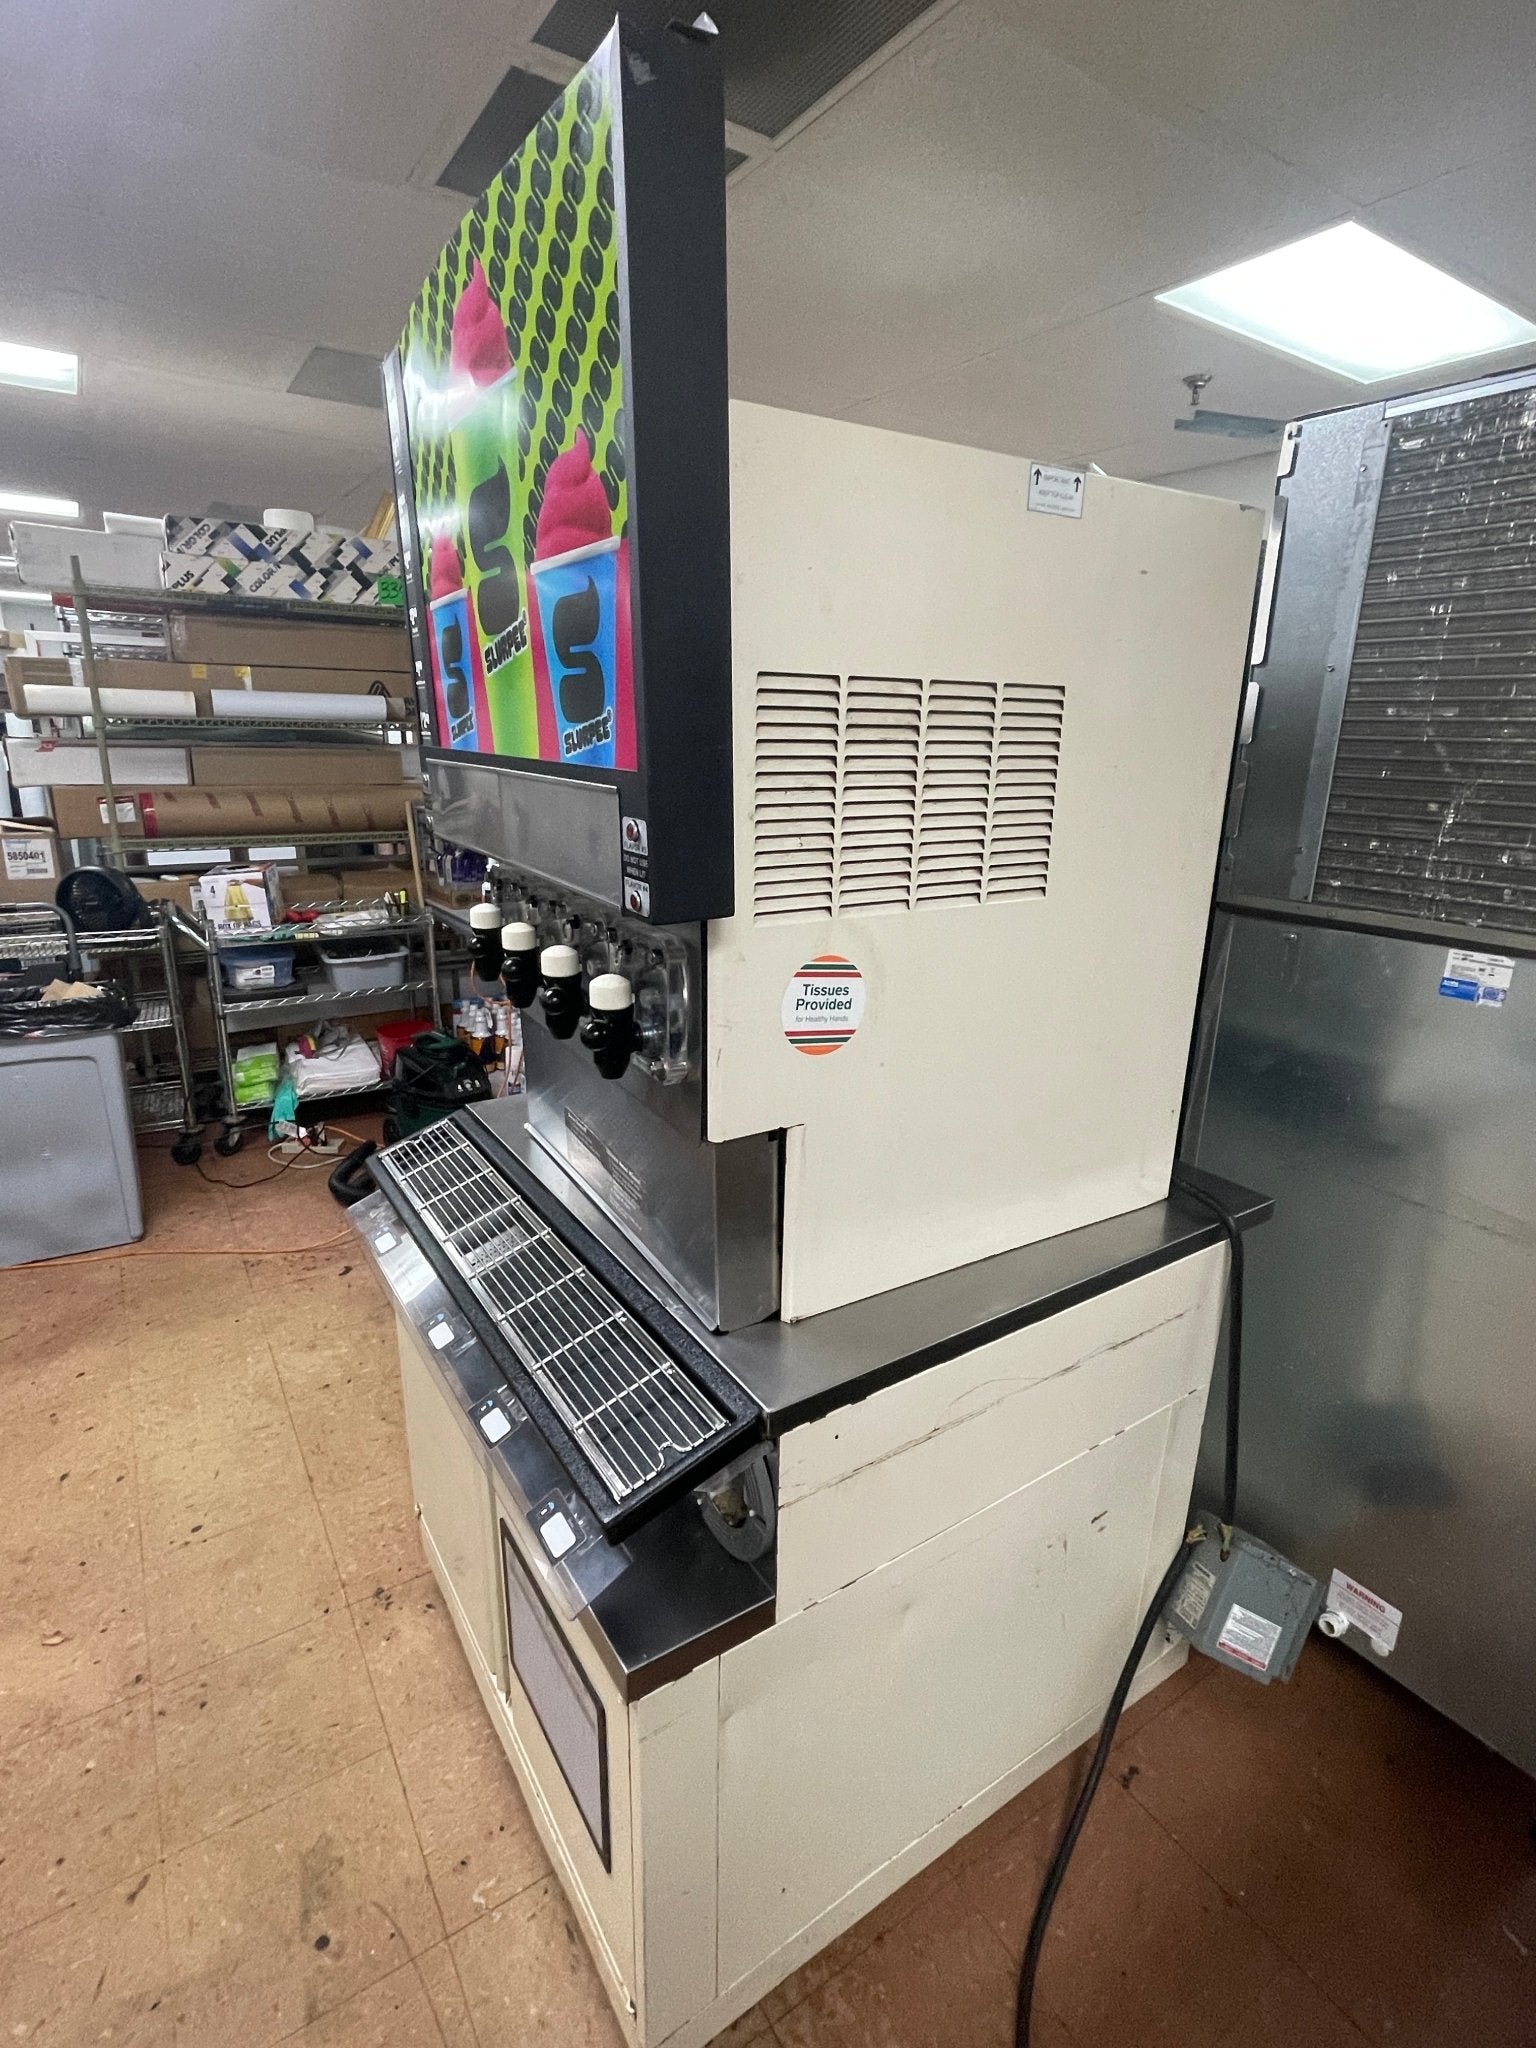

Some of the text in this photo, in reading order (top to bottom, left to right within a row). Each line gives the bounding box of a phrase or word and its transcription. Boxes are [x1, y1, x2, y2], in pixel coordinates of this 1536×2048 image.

[7, 851, 46, 862] 5850401
[803, 984, 850, 996] Tissues
[796, 998, 852, 1011] Provided
[795, 1015, 804, 1023] for
[805, 1015, 829, 1024] Healthy
[1346, 1581, 1386, 1613] WARNING
